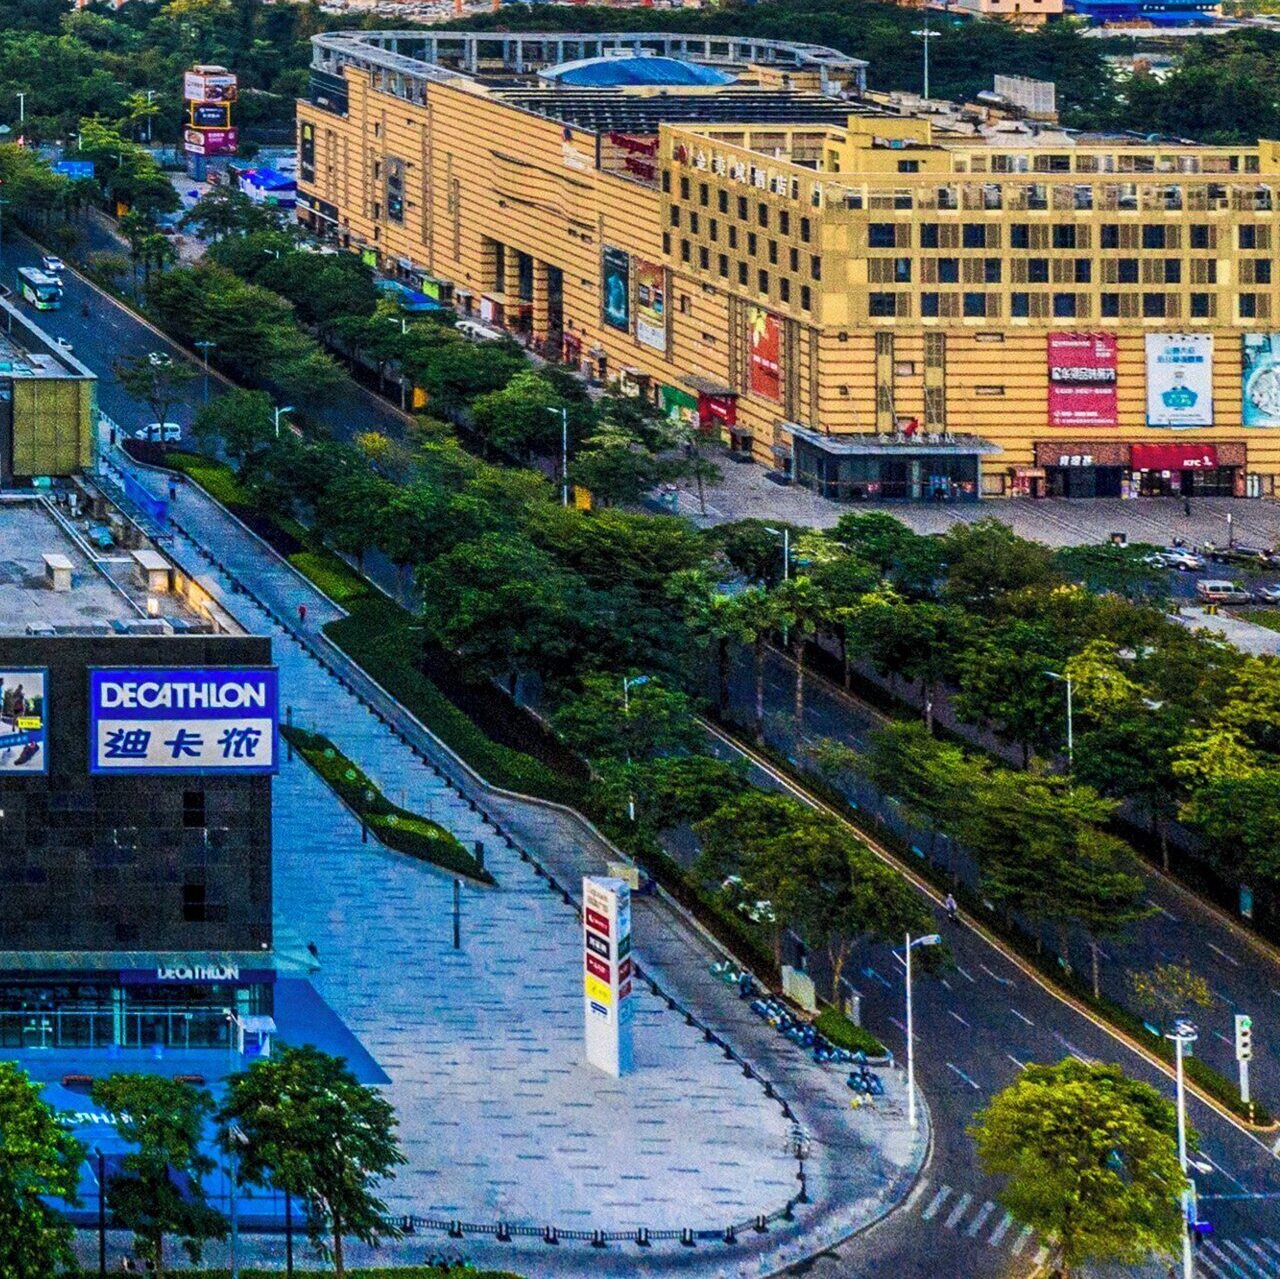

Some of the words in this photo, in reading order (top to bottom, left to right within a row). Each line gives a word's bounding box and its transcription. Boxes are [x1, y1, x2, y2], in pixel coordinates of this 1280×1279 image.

[1183, 459, 1201, 467] KFC
[101, 682, 266, 708] DECATHLON
[104, 727, 262, 759] 迪卡侬
[157, 965, 240, 980] DECATHLON
